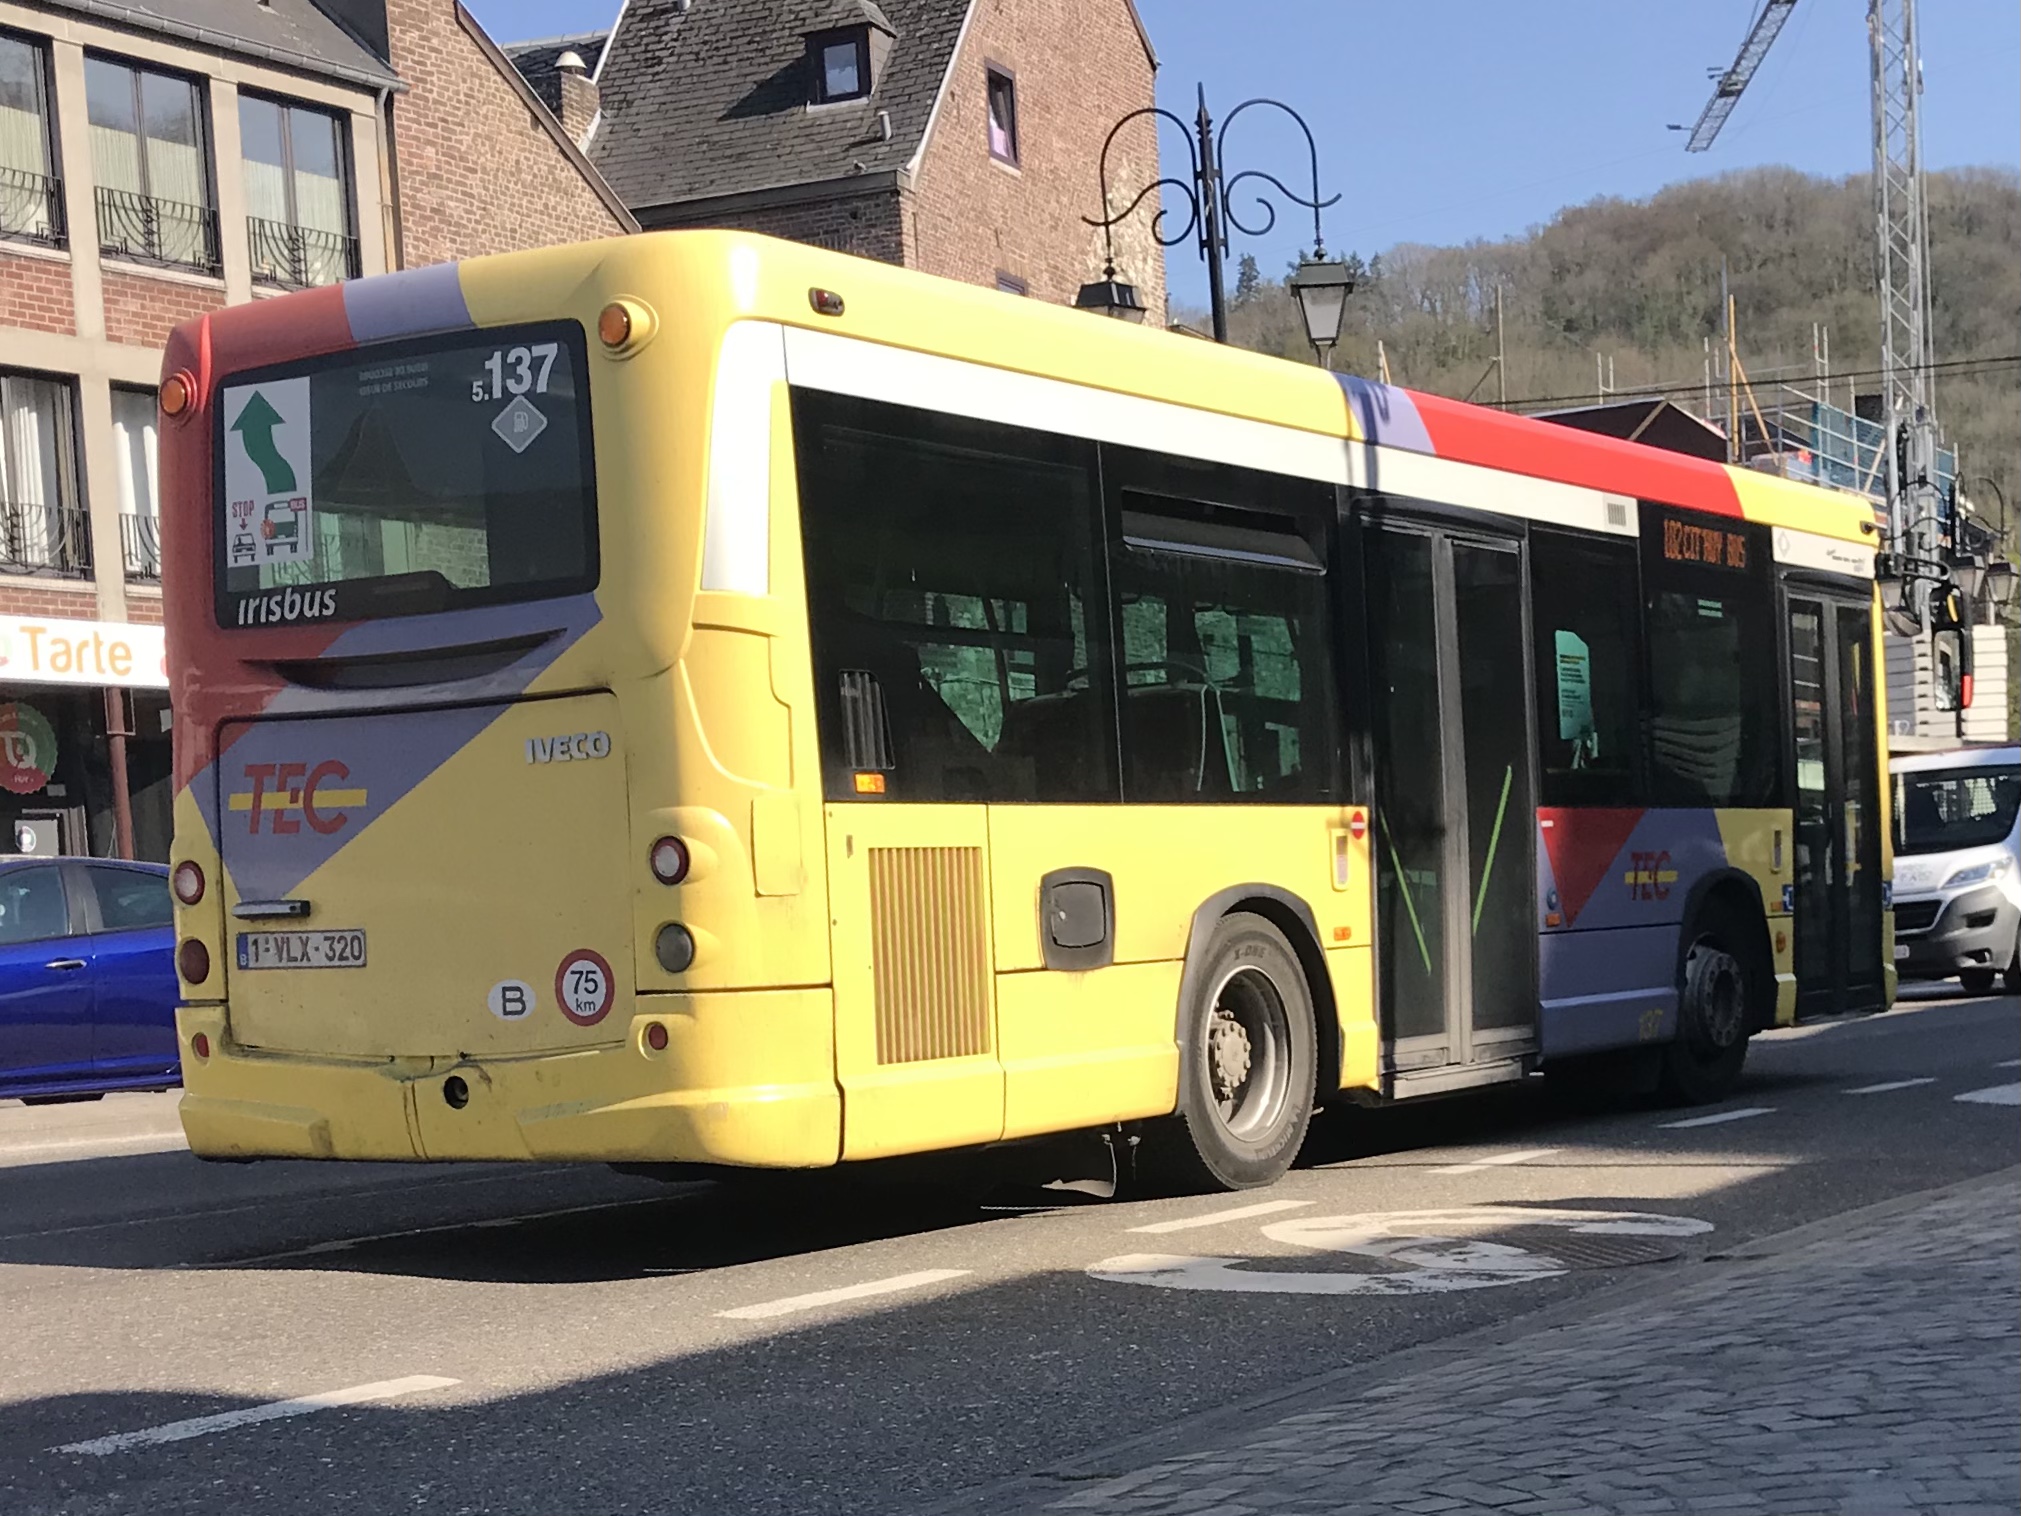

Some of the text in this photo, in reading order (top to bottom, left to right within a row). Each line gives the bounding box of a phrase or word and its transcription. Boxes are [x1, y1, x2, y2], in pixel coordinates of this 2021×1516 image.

[232, 499, 255, 518] STOP
[19, 625, 133, 677] Tarte
[524, 730, 612, 765] IVECO
[243, 759, 351, 835] TEC
[1630, 850, 1672, 901] TEC
[570, 969, 599, 996] 75
[501, 985, 526, 1017] B
[575, 997, 596, 1013] km
